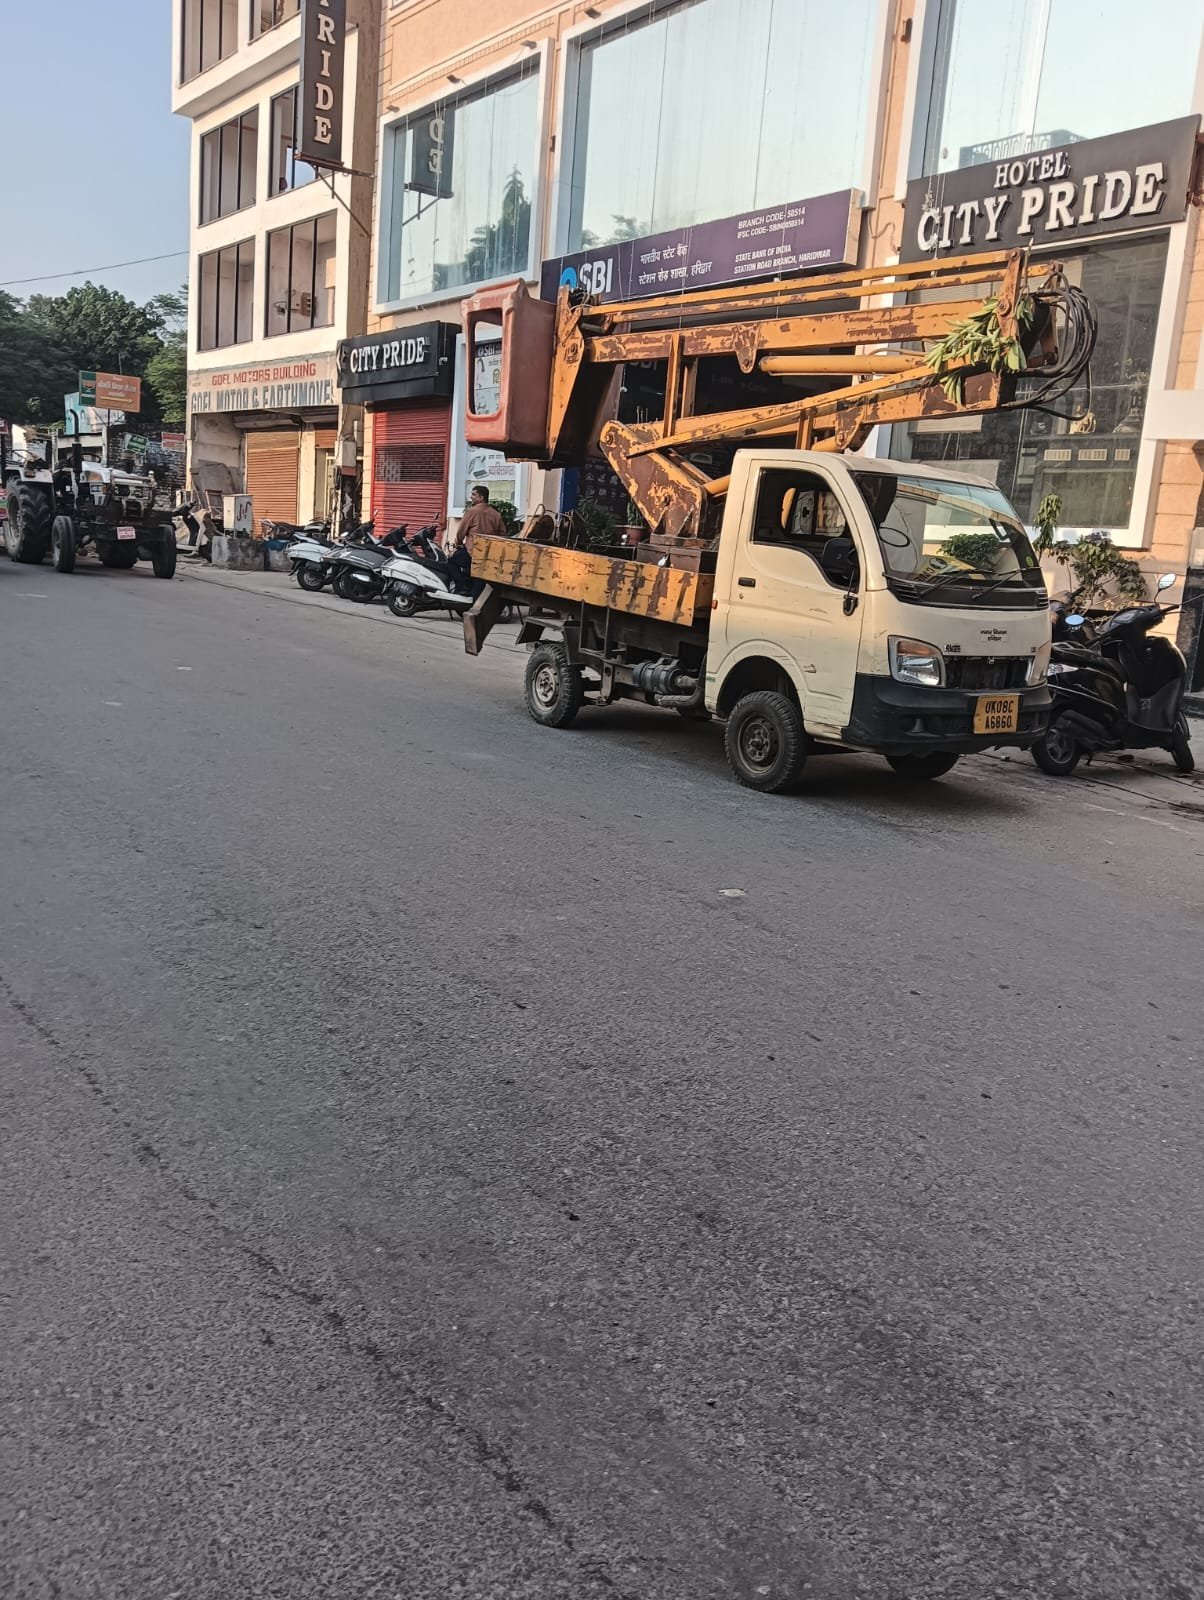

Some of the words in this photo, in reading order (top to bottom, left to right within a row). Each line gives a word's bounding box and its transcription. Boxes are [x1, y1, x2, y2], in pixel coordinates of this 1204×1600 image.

[314, 0, 336, 145] RIDE
[993, 150, 1070, 189] HOTEL
[738, 215, 765, 229] BRANCH
[787, 206, 806, 218] 50514
[917, 194, 1012, 252] CITY
[1016, 161, 1167, 235] PRIDE
[737, 229, 750, 239] IFSC
[640, 248, 661, 264] भारतीय
[662, 245, 676, 260] स्टेट
[734, 263, 757, 274] STATION
[756, 260, 772, 270] ROAD
[798, 248, 831, 262] HARIDWAR
[735, 252, 753, 263] STATE
[752, 249, 767, 260] BANK
[767, 247, 775, 256] OF
[775, 243, 792, 255] INDIA
[579, 258, 614, 295] SBI
[638, 271, 657, 285] स्टेशन
[690, 260, 713, 276] हरिद्वार
[350, 344, 380, 373] CITY
[382, 336, 425, 369] PRIDE
[211, 373, 231, 386] GOEL
[233, 368, 271, 384] MOTORS
[272, 362, 317, 380] BUILDING
[985, 699, 1014, 714] UK08C
[985, 714, 1012, 730] A6860
